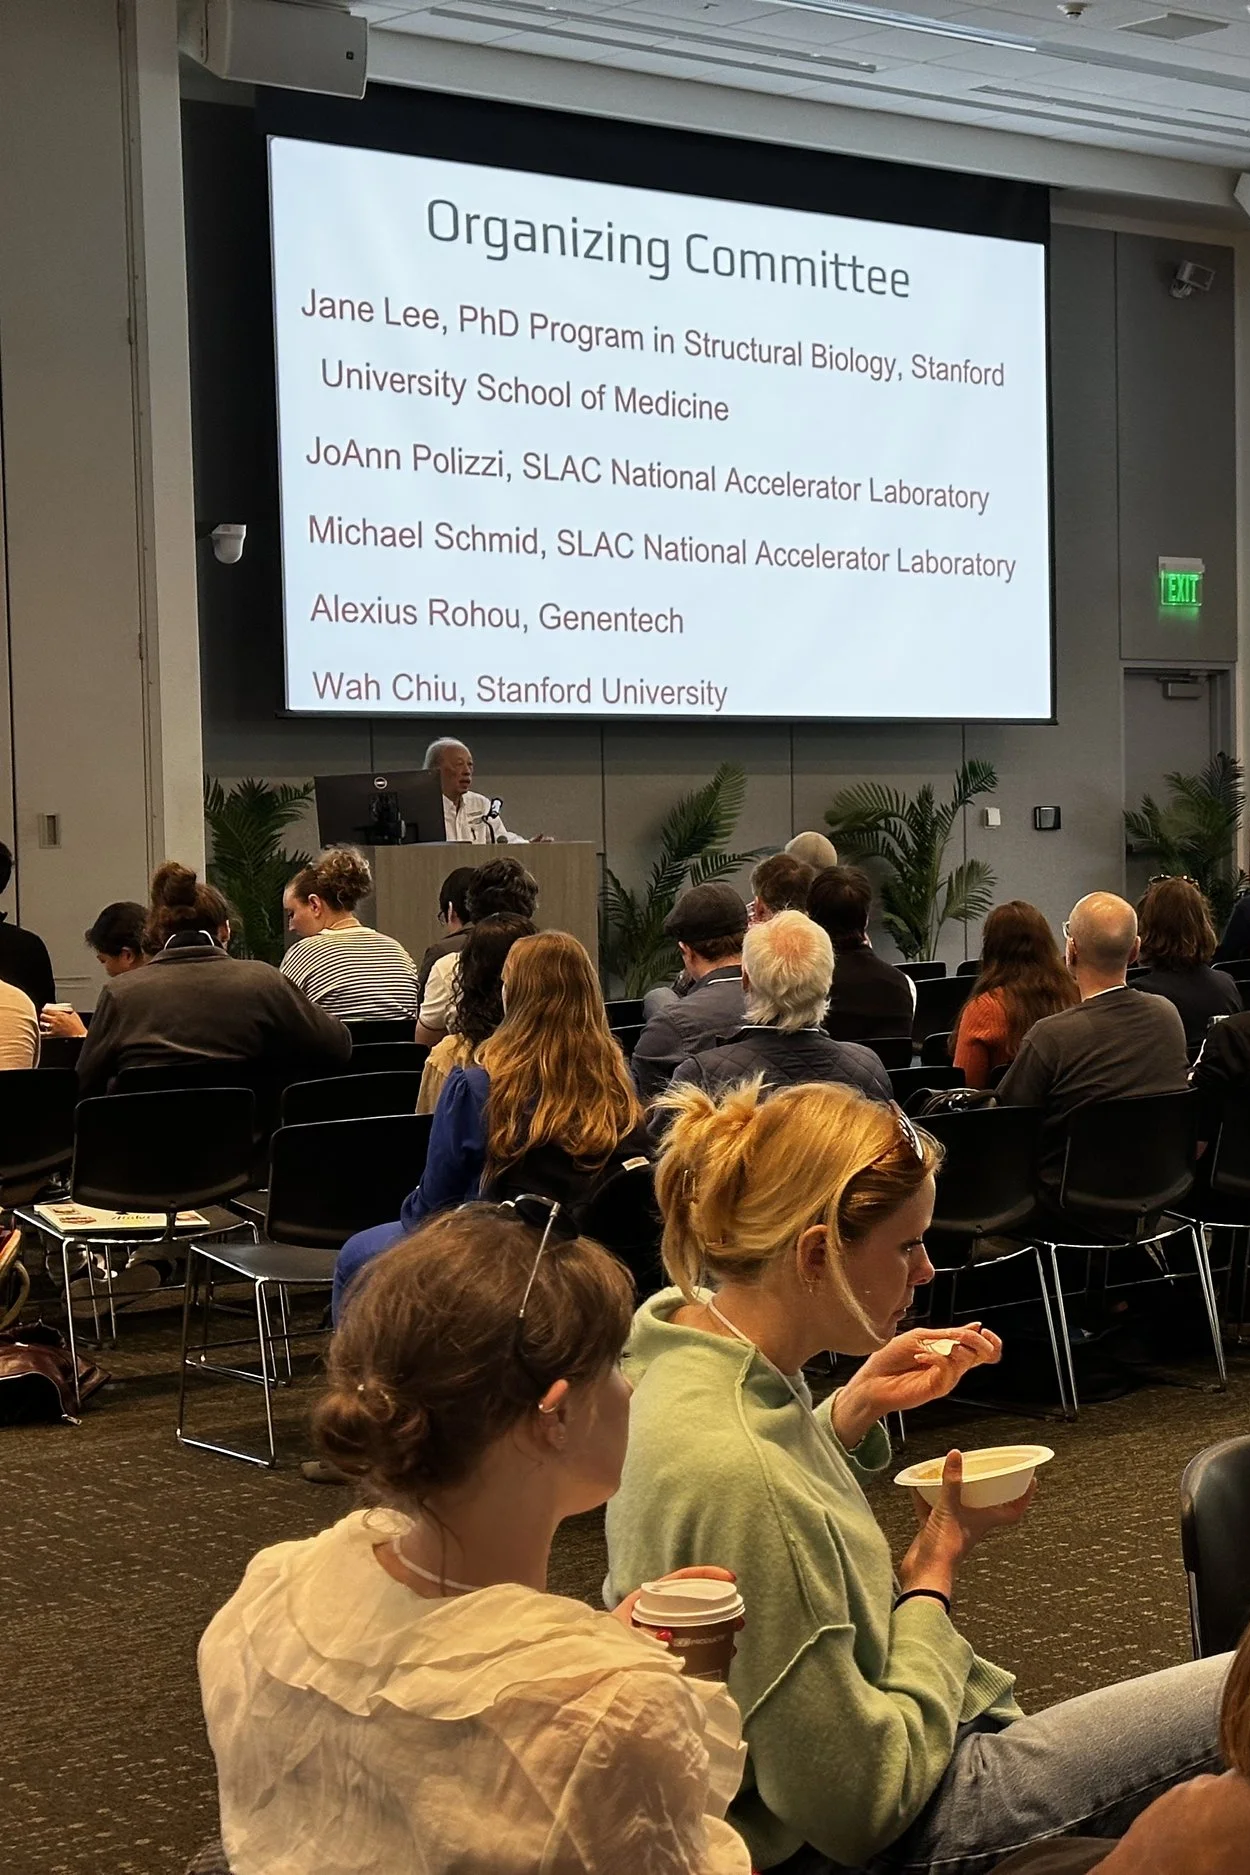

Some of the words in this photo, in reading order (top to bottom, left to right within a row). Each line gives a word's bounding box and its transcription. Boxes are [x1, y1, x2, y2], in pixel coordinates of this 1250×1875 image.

[428, 199, 669, 280] Organizing
[686, 233, 909, 298] Committee
[301, 288, 374, 323] Jane
[384, 297, 447, 336] Lee,
[460, 304, 519, 337] PhD
[530, 312, 644, 352] Program
[654, 325, 674, 354] in
[684, 329, 802, 367] Structural
[812, 343, 902, 382] Biology,
[912, 354, 1004, 387] Stanford
[322, 358, 467, 406] University
[477, 373, 570, 408] School
[581, 384, 607, 411] of
[614, 385, 729, 421] Medicine
[306, 436, 401, 470] JoAnn
[413, 444, 511, 483] Polizzi,
[523, 452, 602, 484] SLAC
[612, 458, 716, 492] National
[724, 467, 862, 501] Accelerator
[869, 477, 990, 516] Laboratory
[309, 515, 422, 549] Michael
[434, 522, 546, 560] Schmid,
[557, 529, 634, 559] SLAC
[644, 533, 746, 565] National
[755, 540, 891, 572] Accelerator
[898, 547, 1016, 584] Laboratory
[310, 593, 418, 625] Alexius
[429, 598, 528, 634] Rohou,
[539, 603, 683, 634] Genentech
[1168, 573, 1199, 602] EXIT
[312, 671, 381, 702] Wah
[392, 673, 465, 707] Chiu,
[477, 675, 591, 704] Stanford
[603, 677, 728, 710] University
